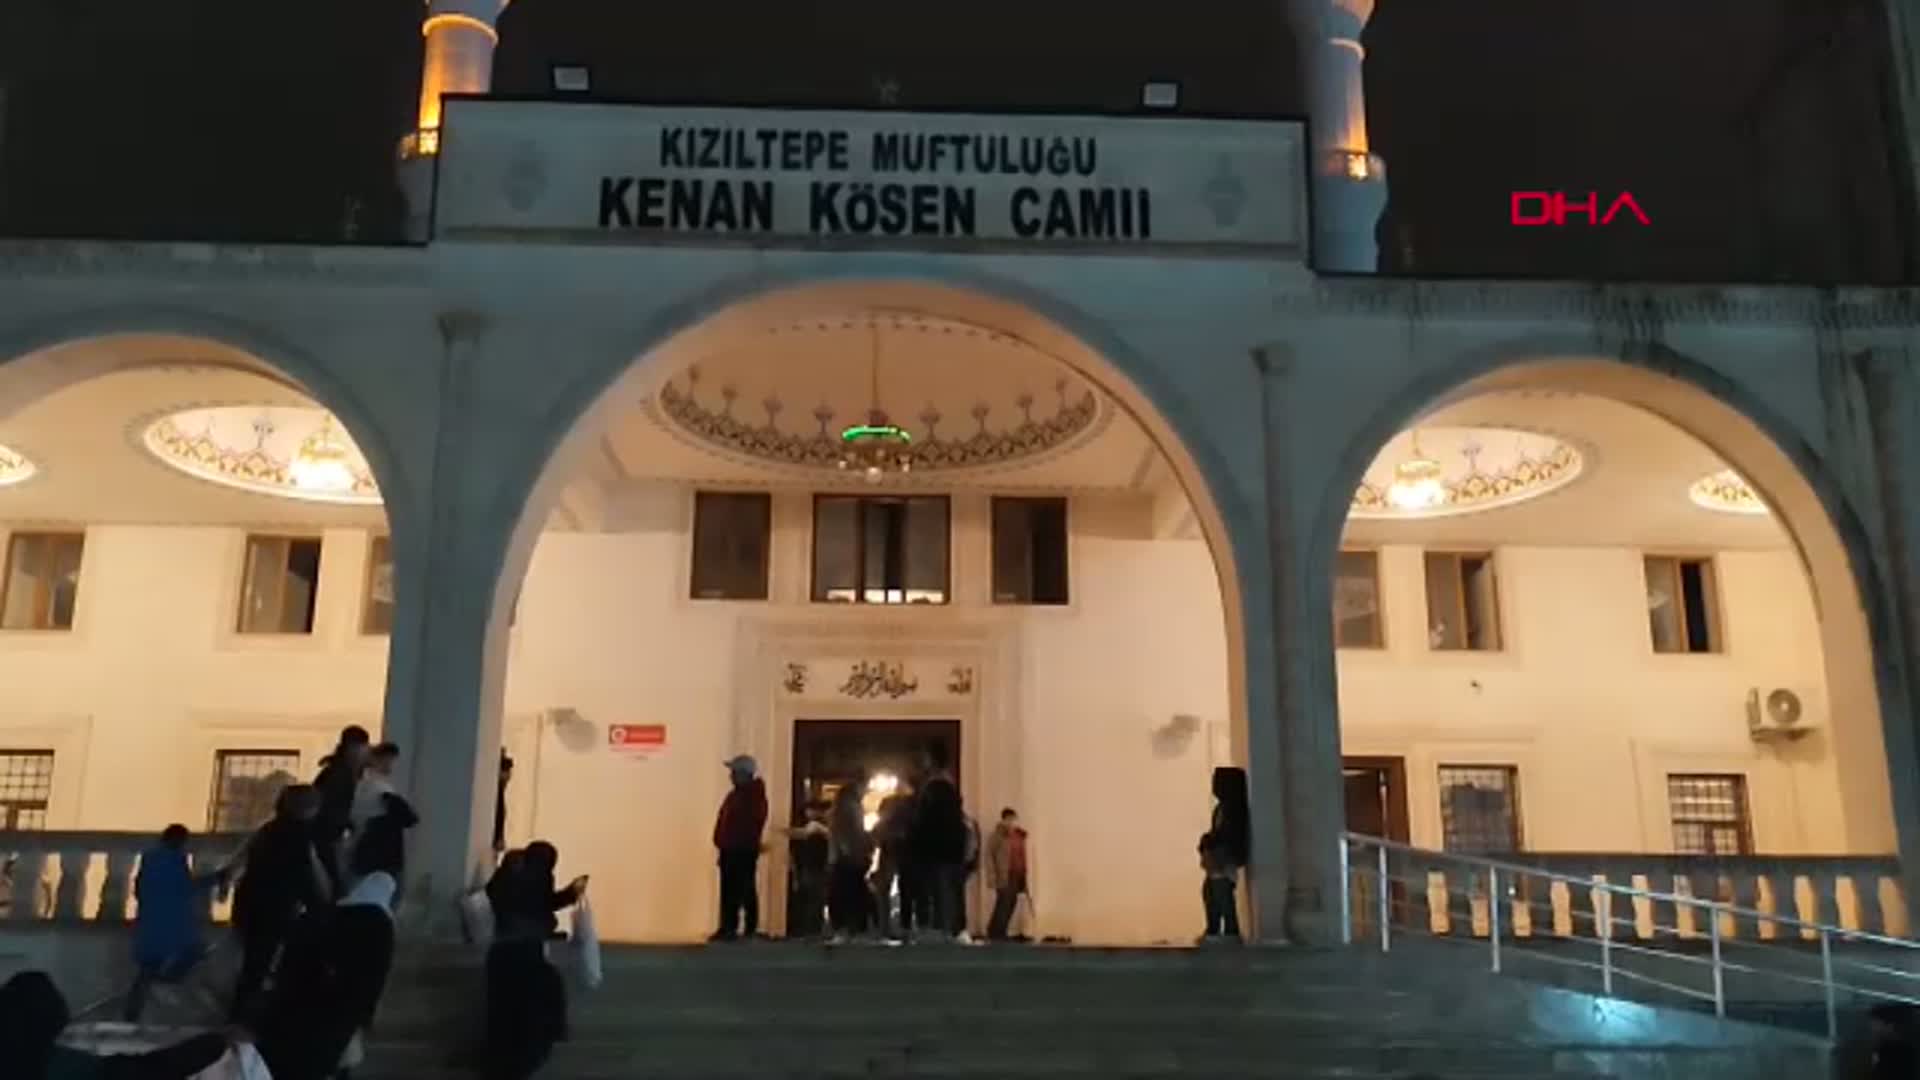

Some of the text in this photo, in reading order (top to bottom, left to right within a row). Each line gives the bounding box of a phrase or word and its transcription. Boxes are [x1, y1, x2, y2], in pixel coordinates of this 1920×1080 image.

[660, 127, 849, 170] KIZILTEPE
[599, 177, 774, 232] KENAN
[809, 181, 976, 236] KÖSEN
